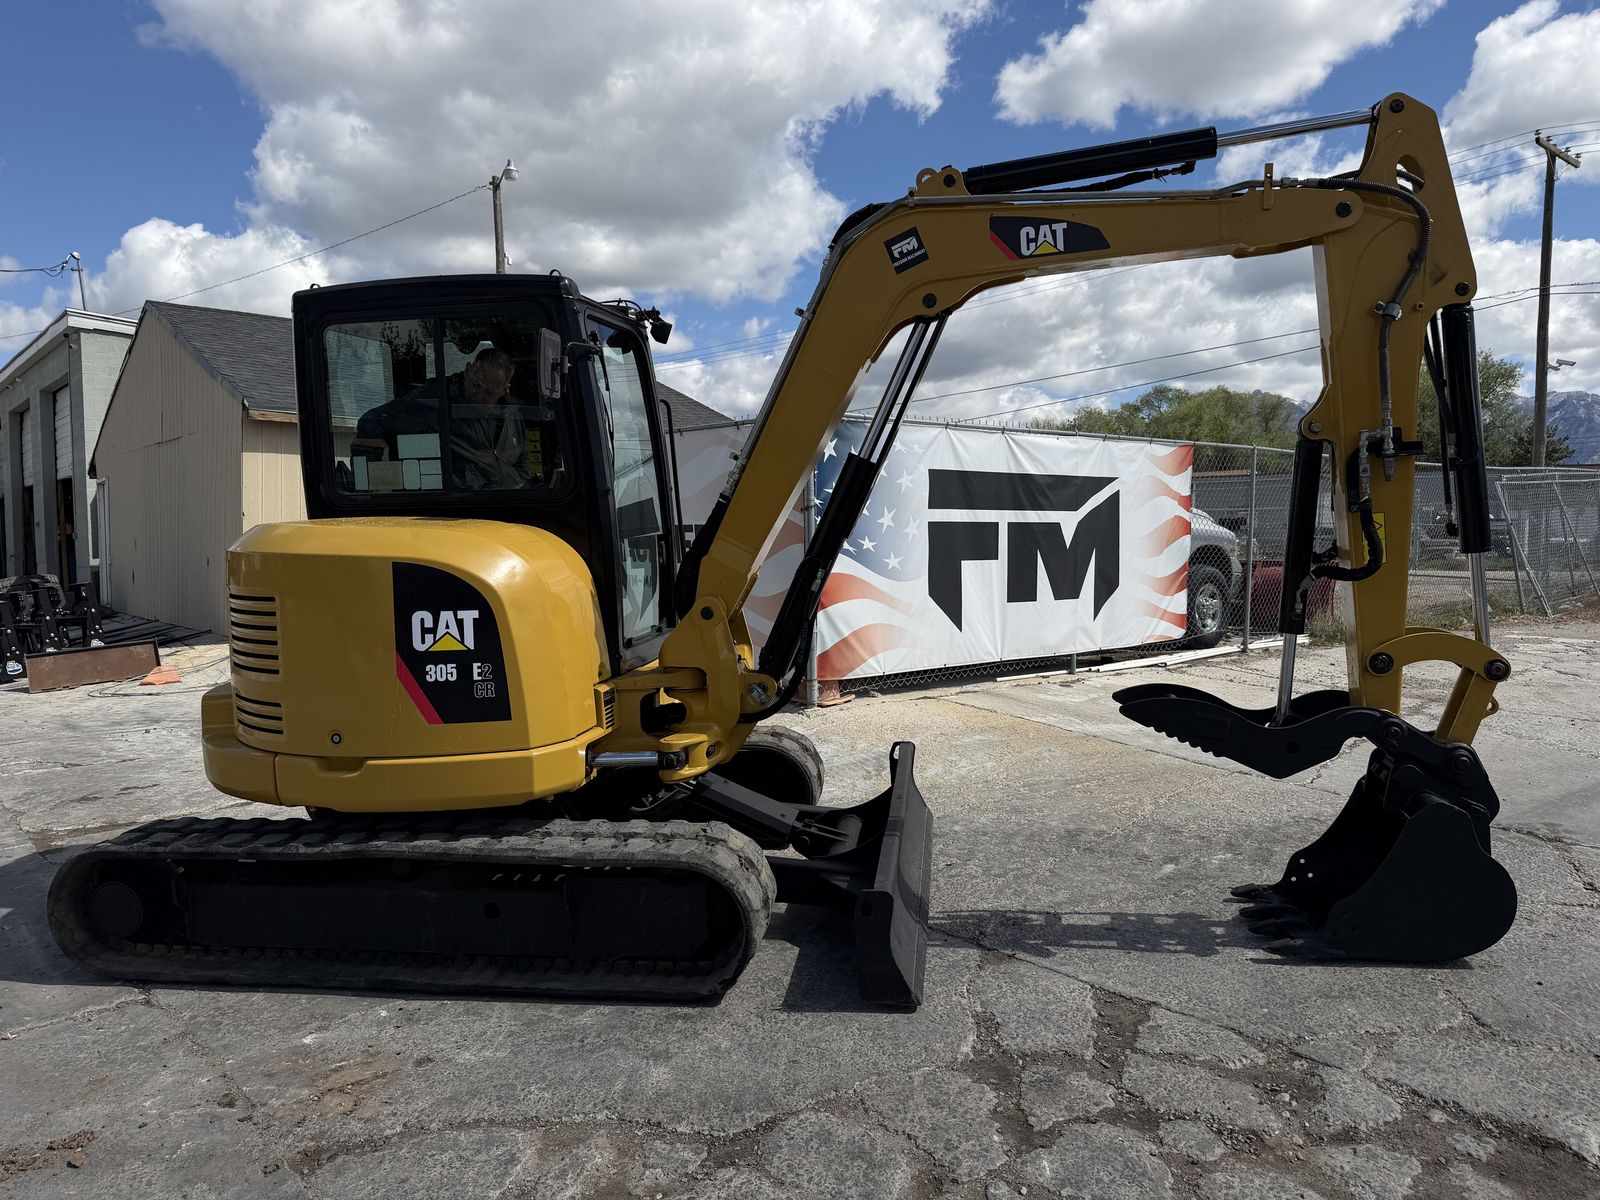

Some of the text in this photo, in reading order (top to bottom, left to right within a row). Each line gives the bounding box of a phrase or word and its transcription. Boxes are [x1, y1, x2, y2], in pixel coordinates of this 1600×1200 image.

[890, 235, 919, 259] FM
[1019, 222, 1068, 257] CAT
[927, 468, 1121, 633] FM
[411, 610, 480, 652] CAT
[425, 662, 493, 683] 305 E2
[473, 681, 496, 698] CR
